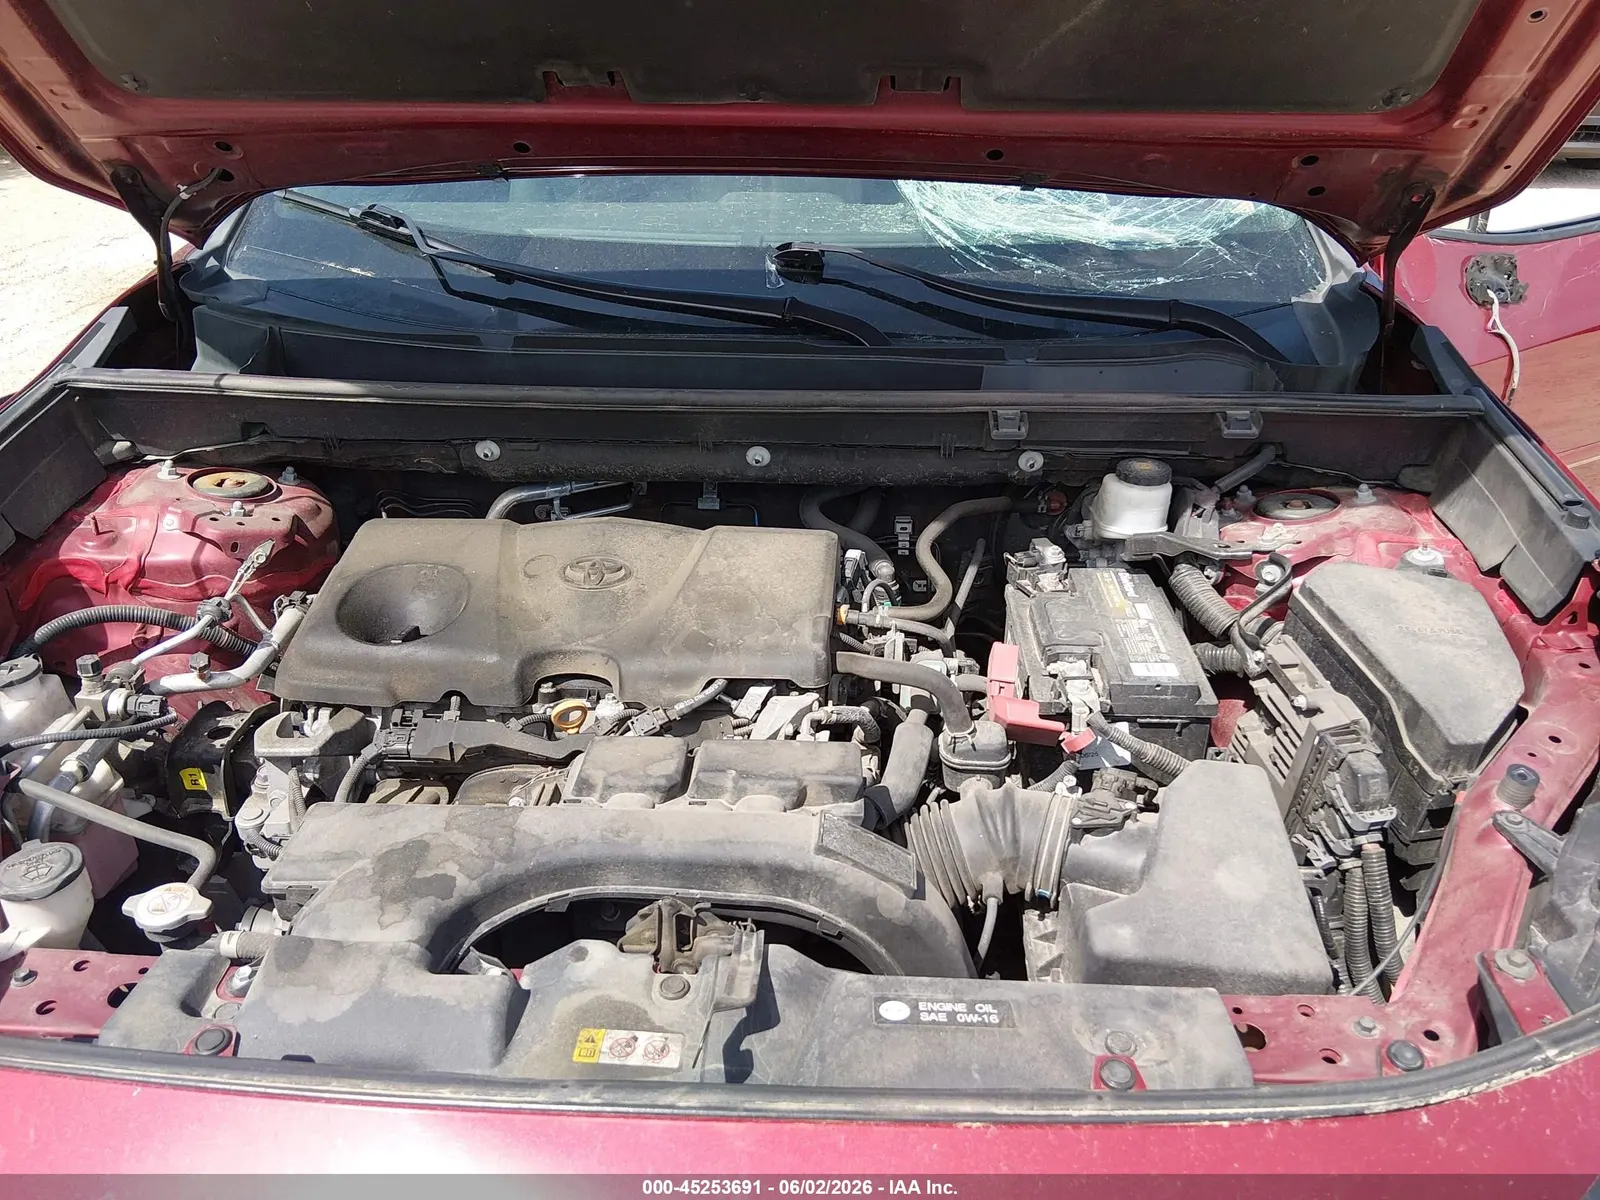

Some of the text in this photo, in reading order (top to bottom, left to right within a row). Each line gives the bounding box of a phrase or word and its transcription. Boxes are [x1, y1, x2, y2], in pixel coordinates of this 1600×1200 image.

[188, 773, 200, 786] R1
[918, 1001, 998, 1013] ENGINE OIL
[919, 1012, 1000, 1024] SAE 0W-16
